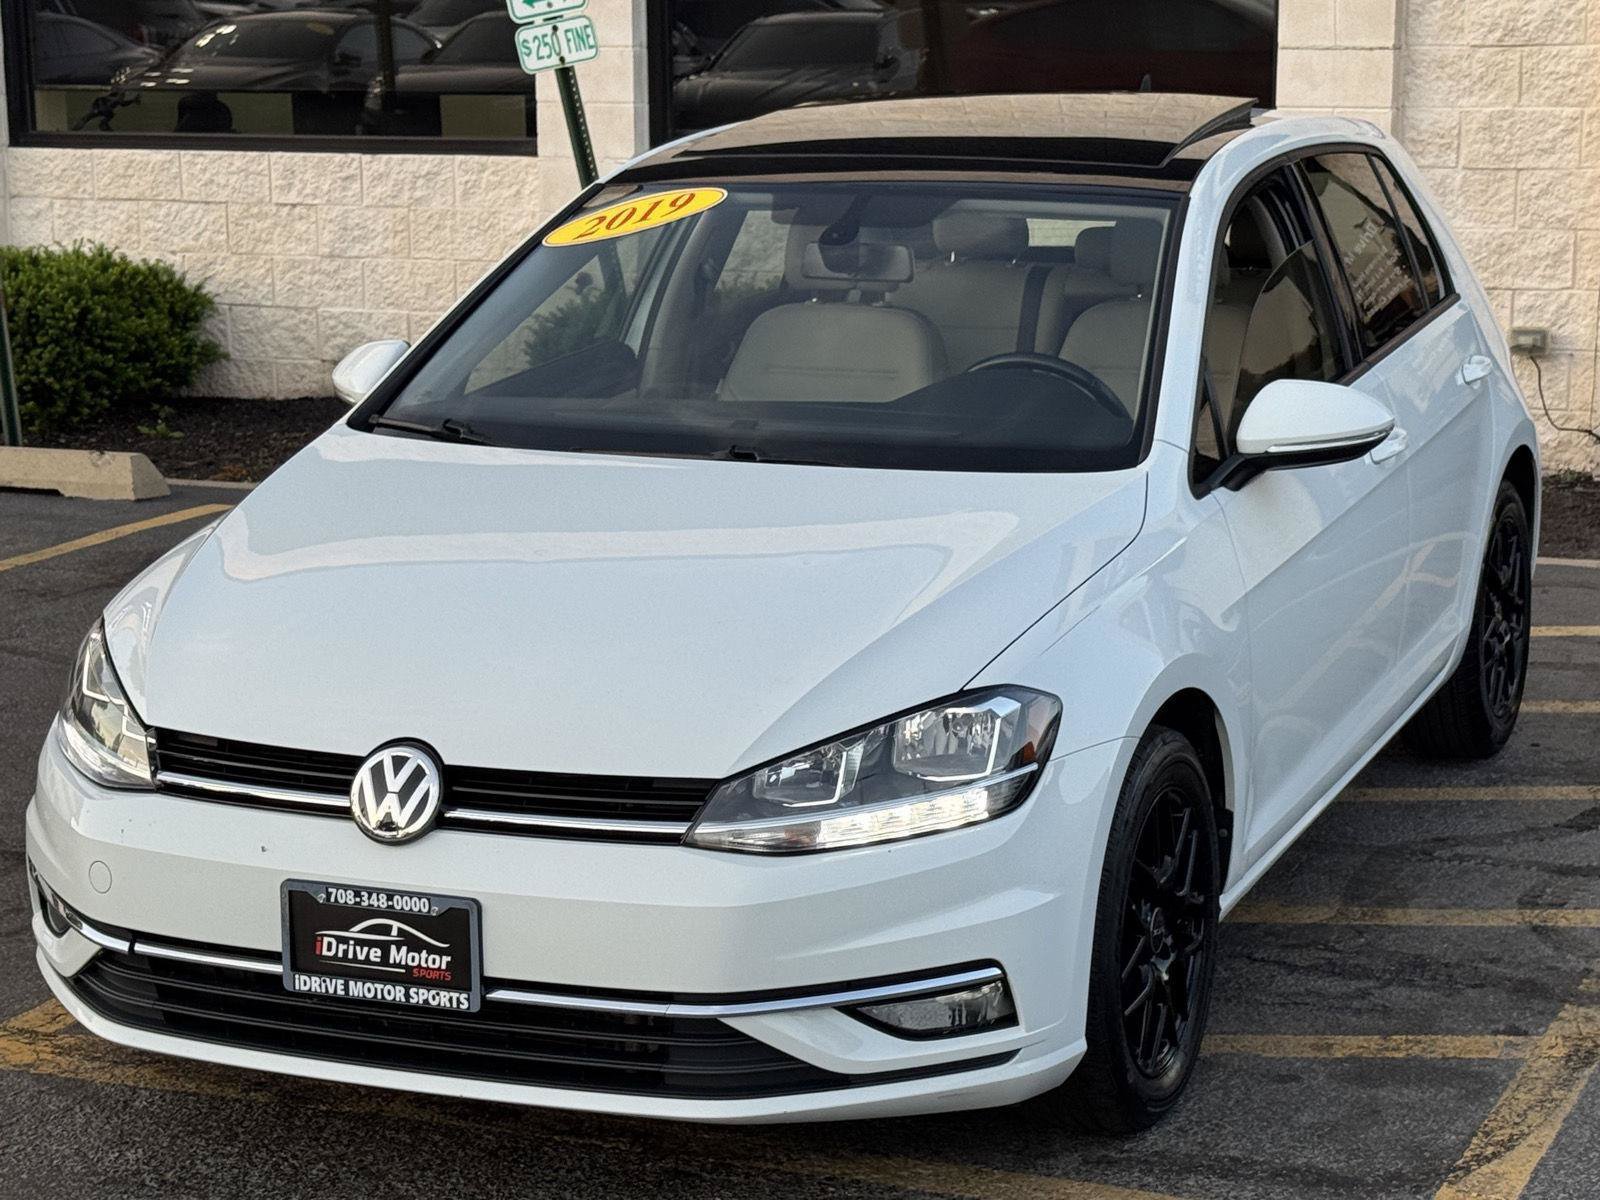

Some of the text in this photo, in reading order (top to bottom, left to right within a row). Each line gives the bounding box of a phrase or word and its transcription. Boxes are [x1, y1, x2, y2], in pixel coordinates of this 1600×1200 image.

[521, 25, 596, 60] $250 FINE
[572, 192, 696, 240] 2019
[328, 888, 430, 913] 708-348-0000
[315, 936, 451, 970] iDrive Motor
[412, 968, 452, 981] SPORTS
[349, 980, 406, 1002] MOTOR
[409, 987, 469, 1010] SPORTS
